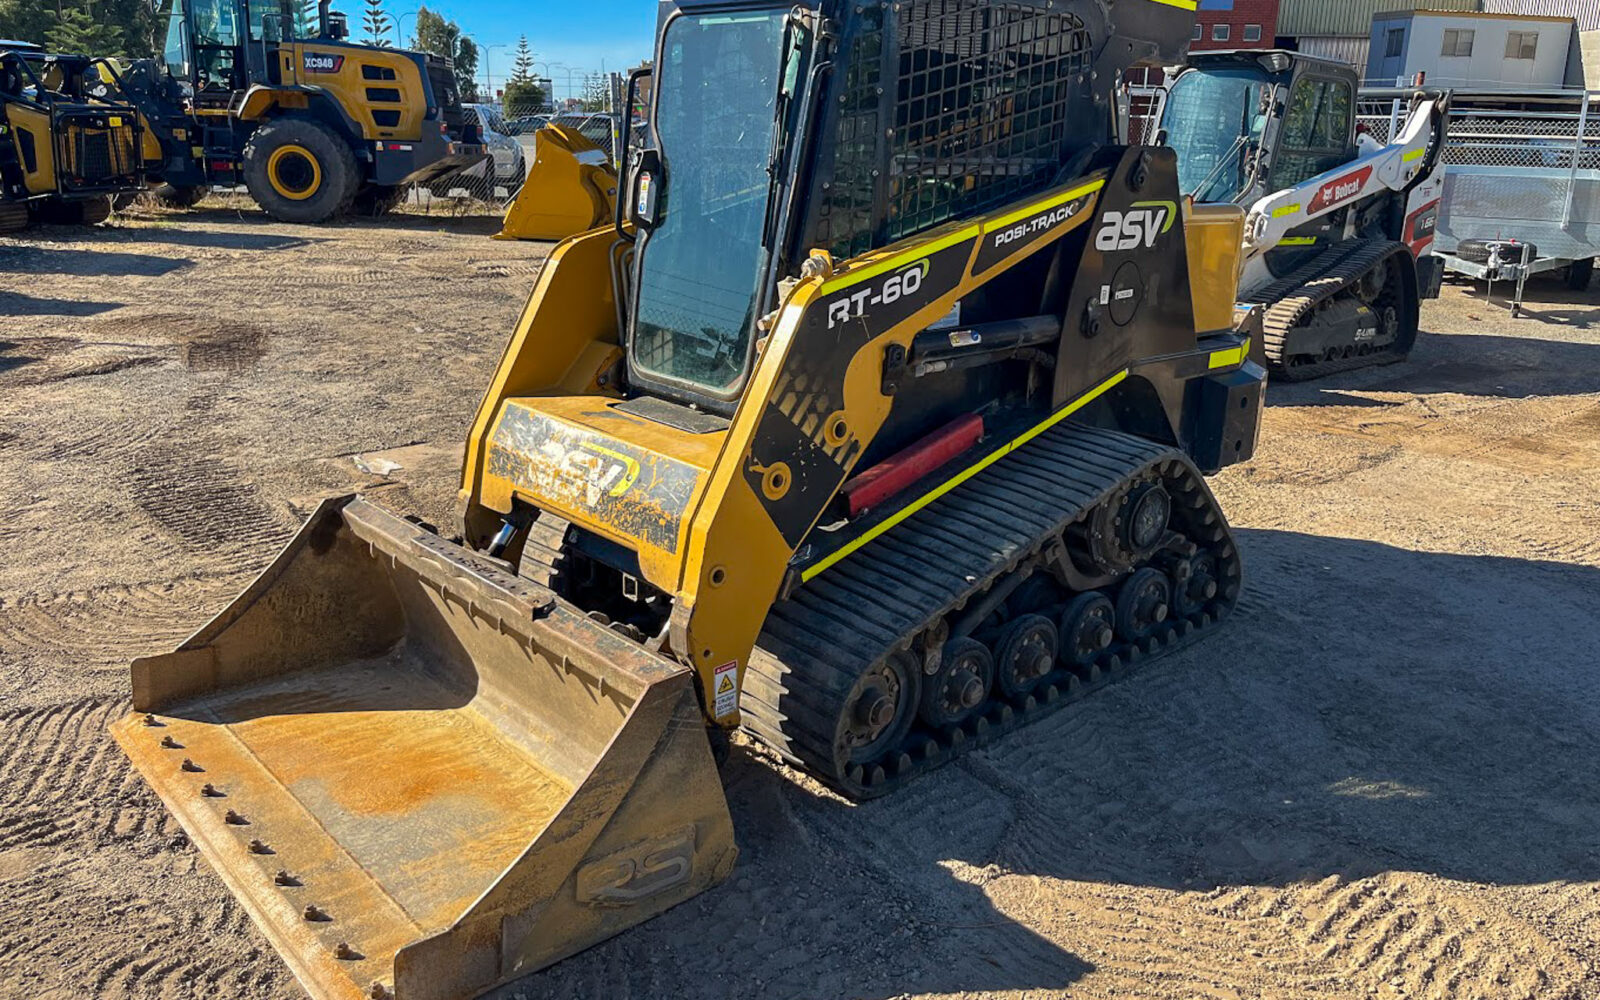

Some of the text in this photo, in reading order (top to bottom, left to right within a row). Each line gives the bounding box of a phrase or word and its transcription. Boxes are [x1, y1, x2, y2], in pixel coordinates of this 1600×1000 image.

[304, 57, 334, 69] XC948
[1334, 178, 1361, 201] Bobcat
[995, 204, 1074, 248] POSI-TRACK
[828, 267, 923, 329] RT-60
